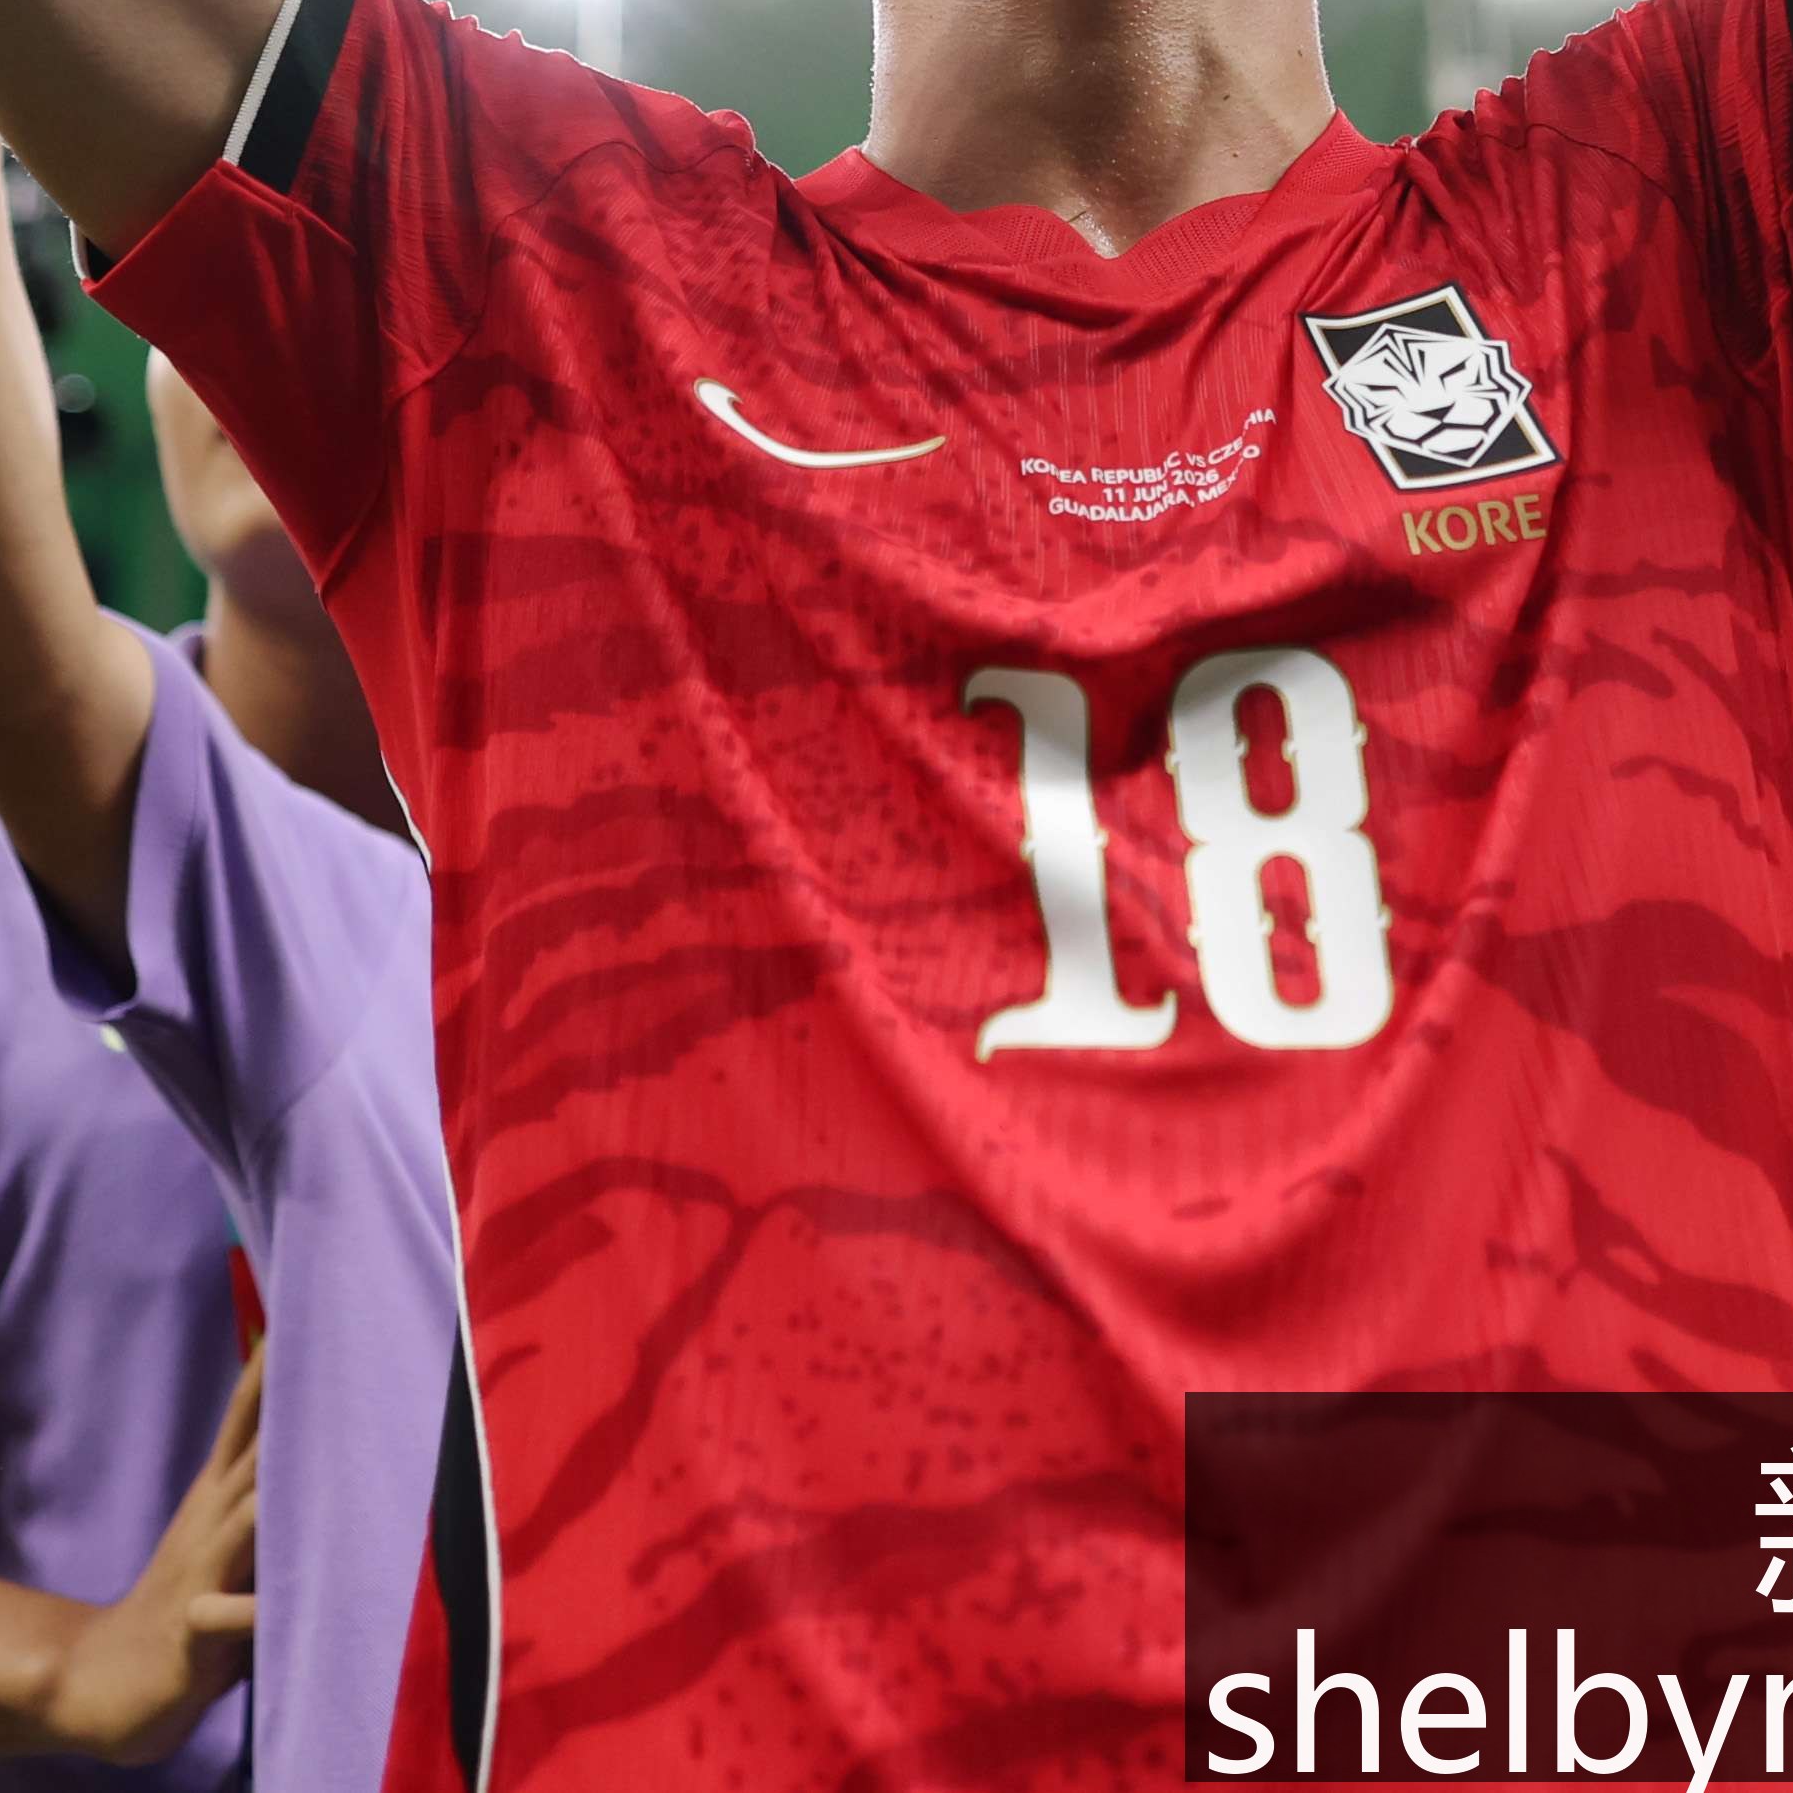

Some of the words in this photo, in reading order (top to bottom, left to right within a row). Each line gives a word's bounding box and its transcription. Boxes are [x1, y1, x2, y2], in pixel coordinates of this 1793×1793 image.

[1091, 451, 1181, 484] REPUBLIC
[1185, 452, 1207, 468] VS
[1103, 488, 1126, 503] 11
[1133, 480, 1169, 503] JUN
[1171, 468, 1220, 486] 2026
[1048, 488, 1195, 522] GUADALAJARA,
[961, 646, 1395, 1063] 18
